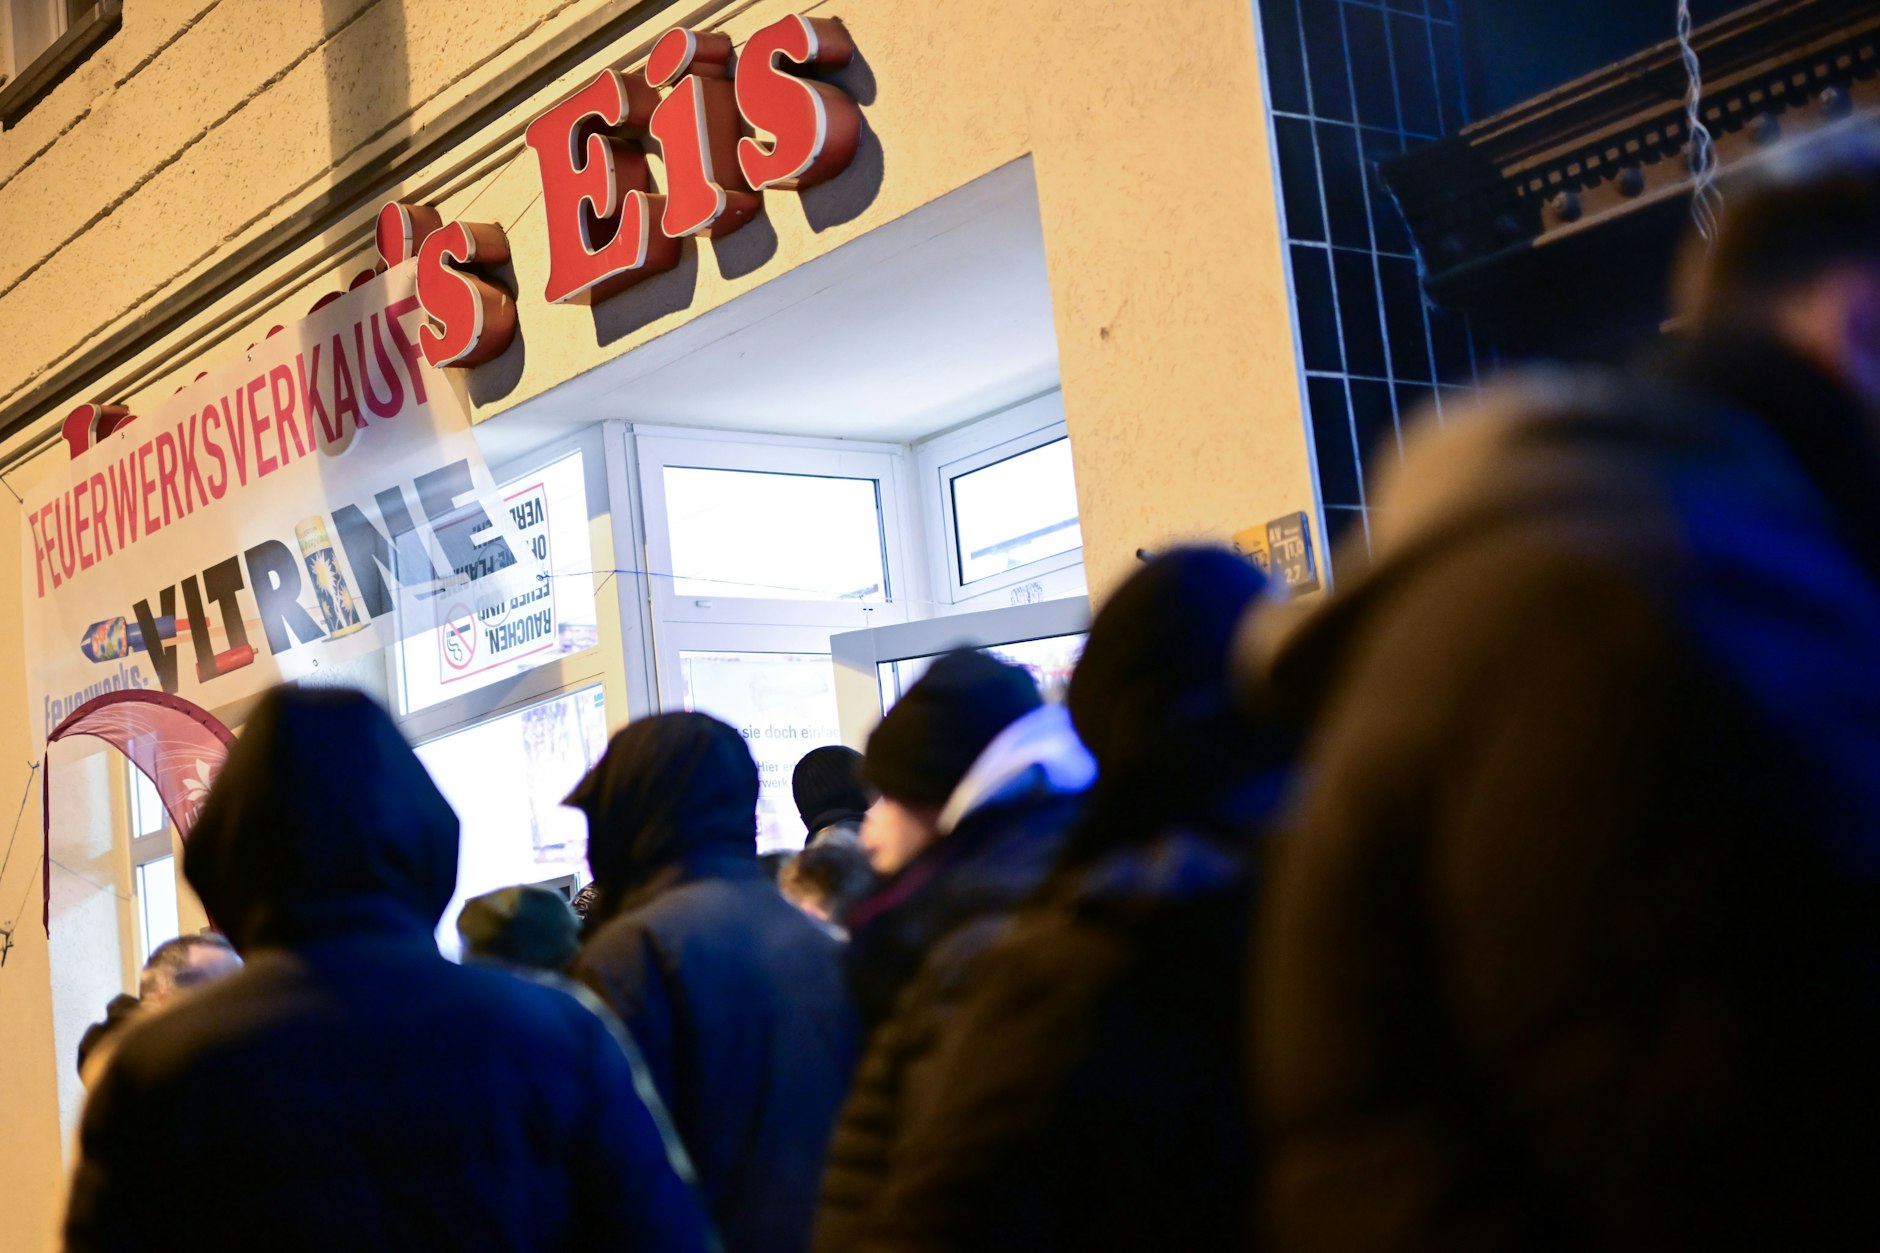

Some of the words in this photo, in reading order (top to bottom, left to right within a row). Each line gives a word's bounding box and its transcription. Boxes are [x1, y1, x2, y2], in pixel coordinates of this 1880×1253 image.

[526, 13, 836, 304] Eis
[29, 294, 428, 598] FEUERWERKSVERKAUF
[485, 607, 551, 655] RAUCHEN,
[742, 725, 761, 739] sie
[764, 725, 797, 739] doch
